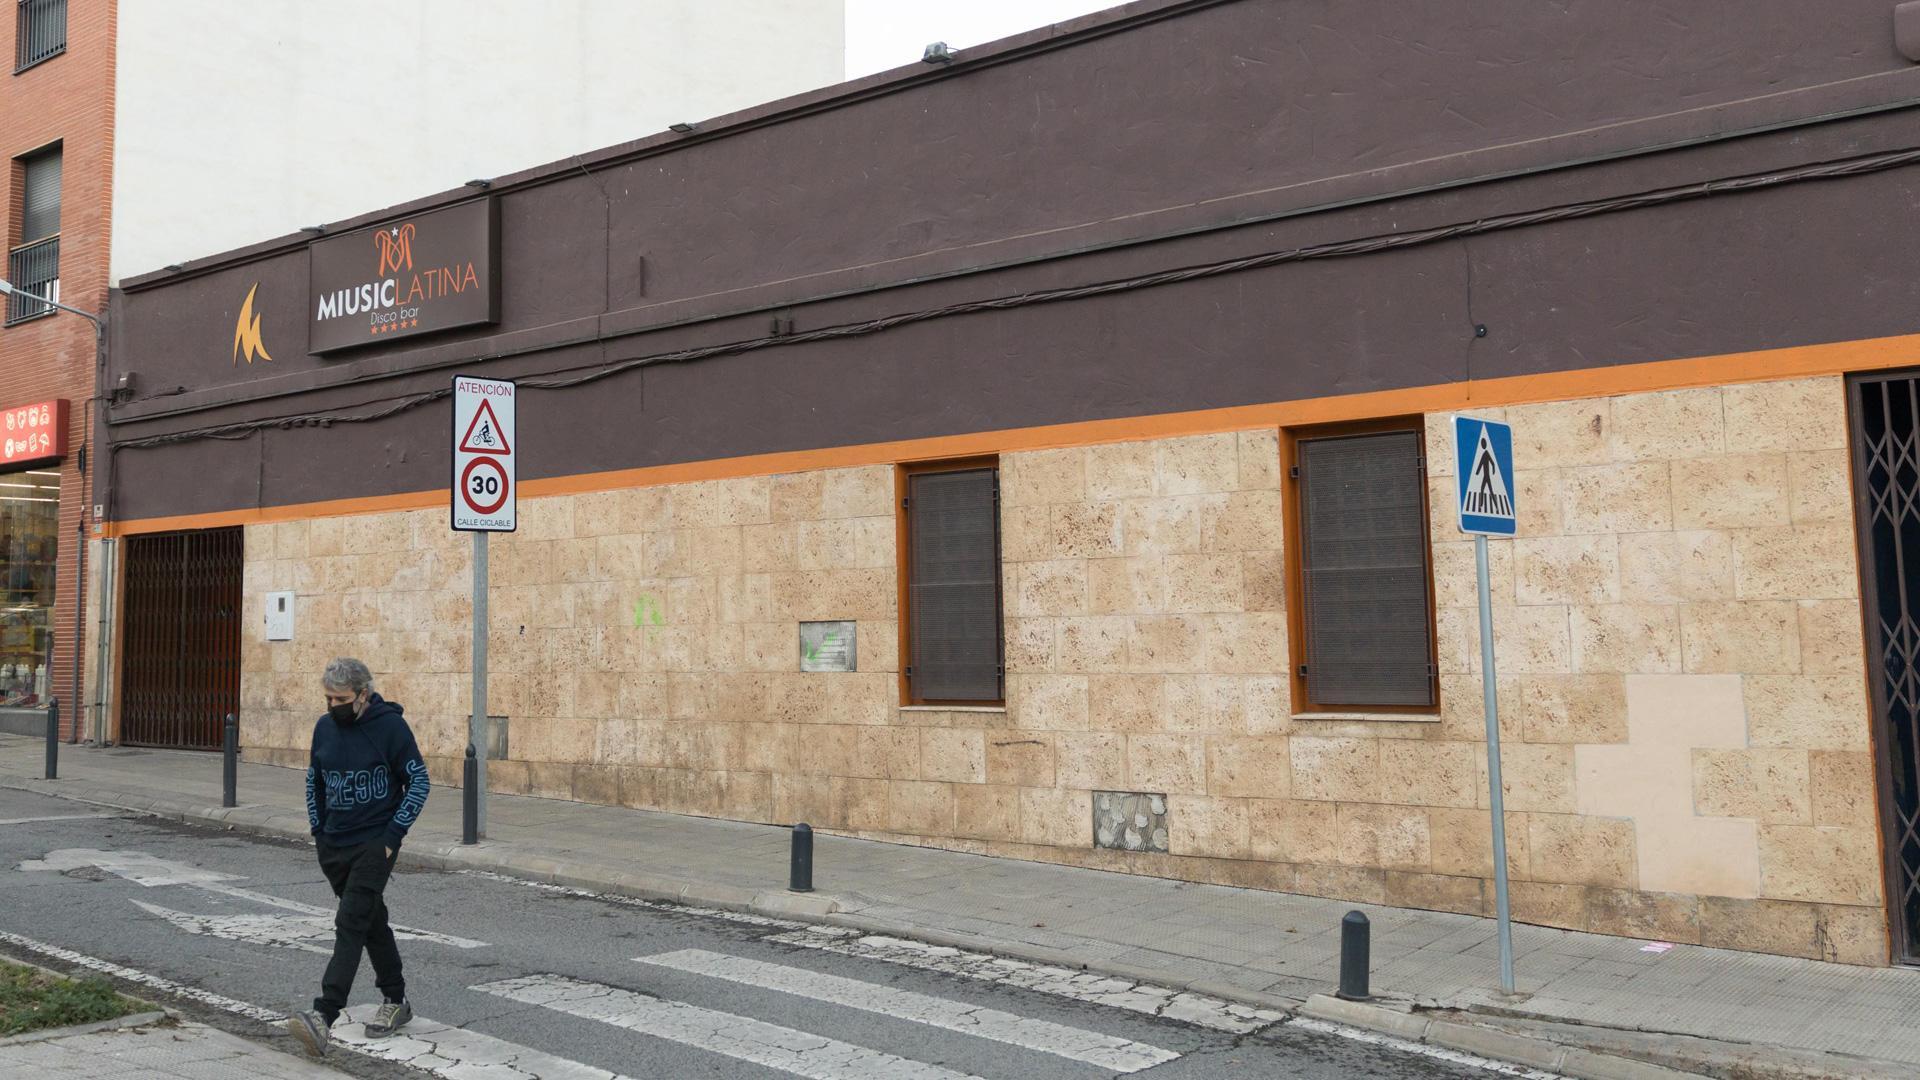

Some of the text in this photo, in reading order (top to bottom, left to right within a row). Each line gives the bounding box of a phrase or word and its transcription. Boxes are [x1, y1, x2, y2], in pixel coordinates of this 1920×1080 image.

[370, 307, 420, 325] Disco bar
[458, 382, 512, 396] ATENCIÓN
[472, 476, 498, 495] 30
[457, 518, 511, 527] CALLE CICLABLE
